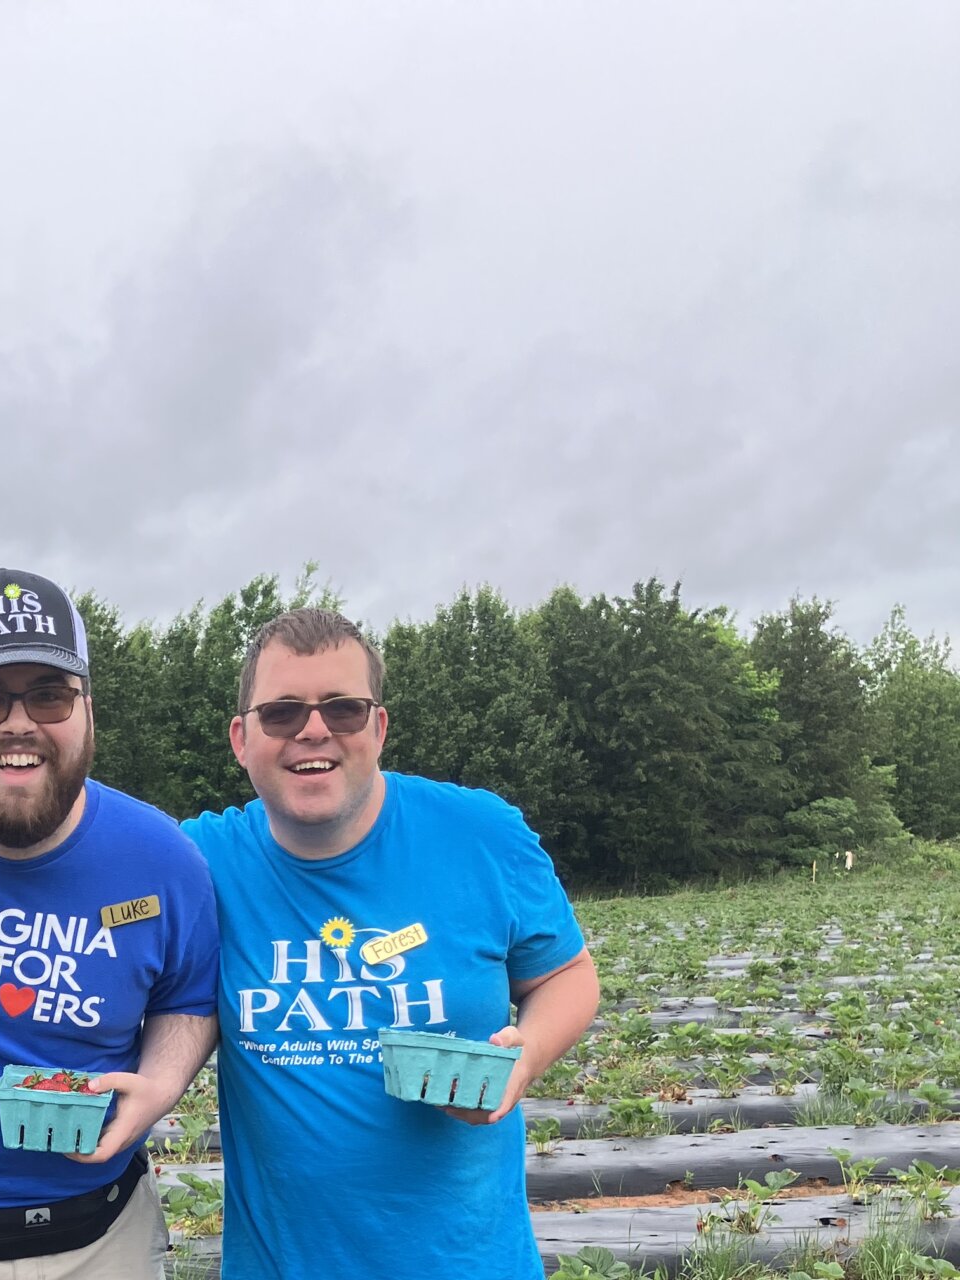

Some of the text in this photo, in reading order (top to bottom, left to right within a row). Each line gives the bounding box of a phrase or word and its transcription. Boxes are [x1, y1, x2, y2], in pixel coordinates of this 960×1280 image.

[109, 899, 150, 924] Luke
[369, 926, 422, 959] Forest
[238, 979, 448, 1032] PATH
[279, 1040, 322, 1052] Adults
[327, 1039, 357, 1051] With
[262, 1054, 324, 1066] Contribute
[329, 1054, 343, 1065] To
[348, 1053, 373, 1064] The
